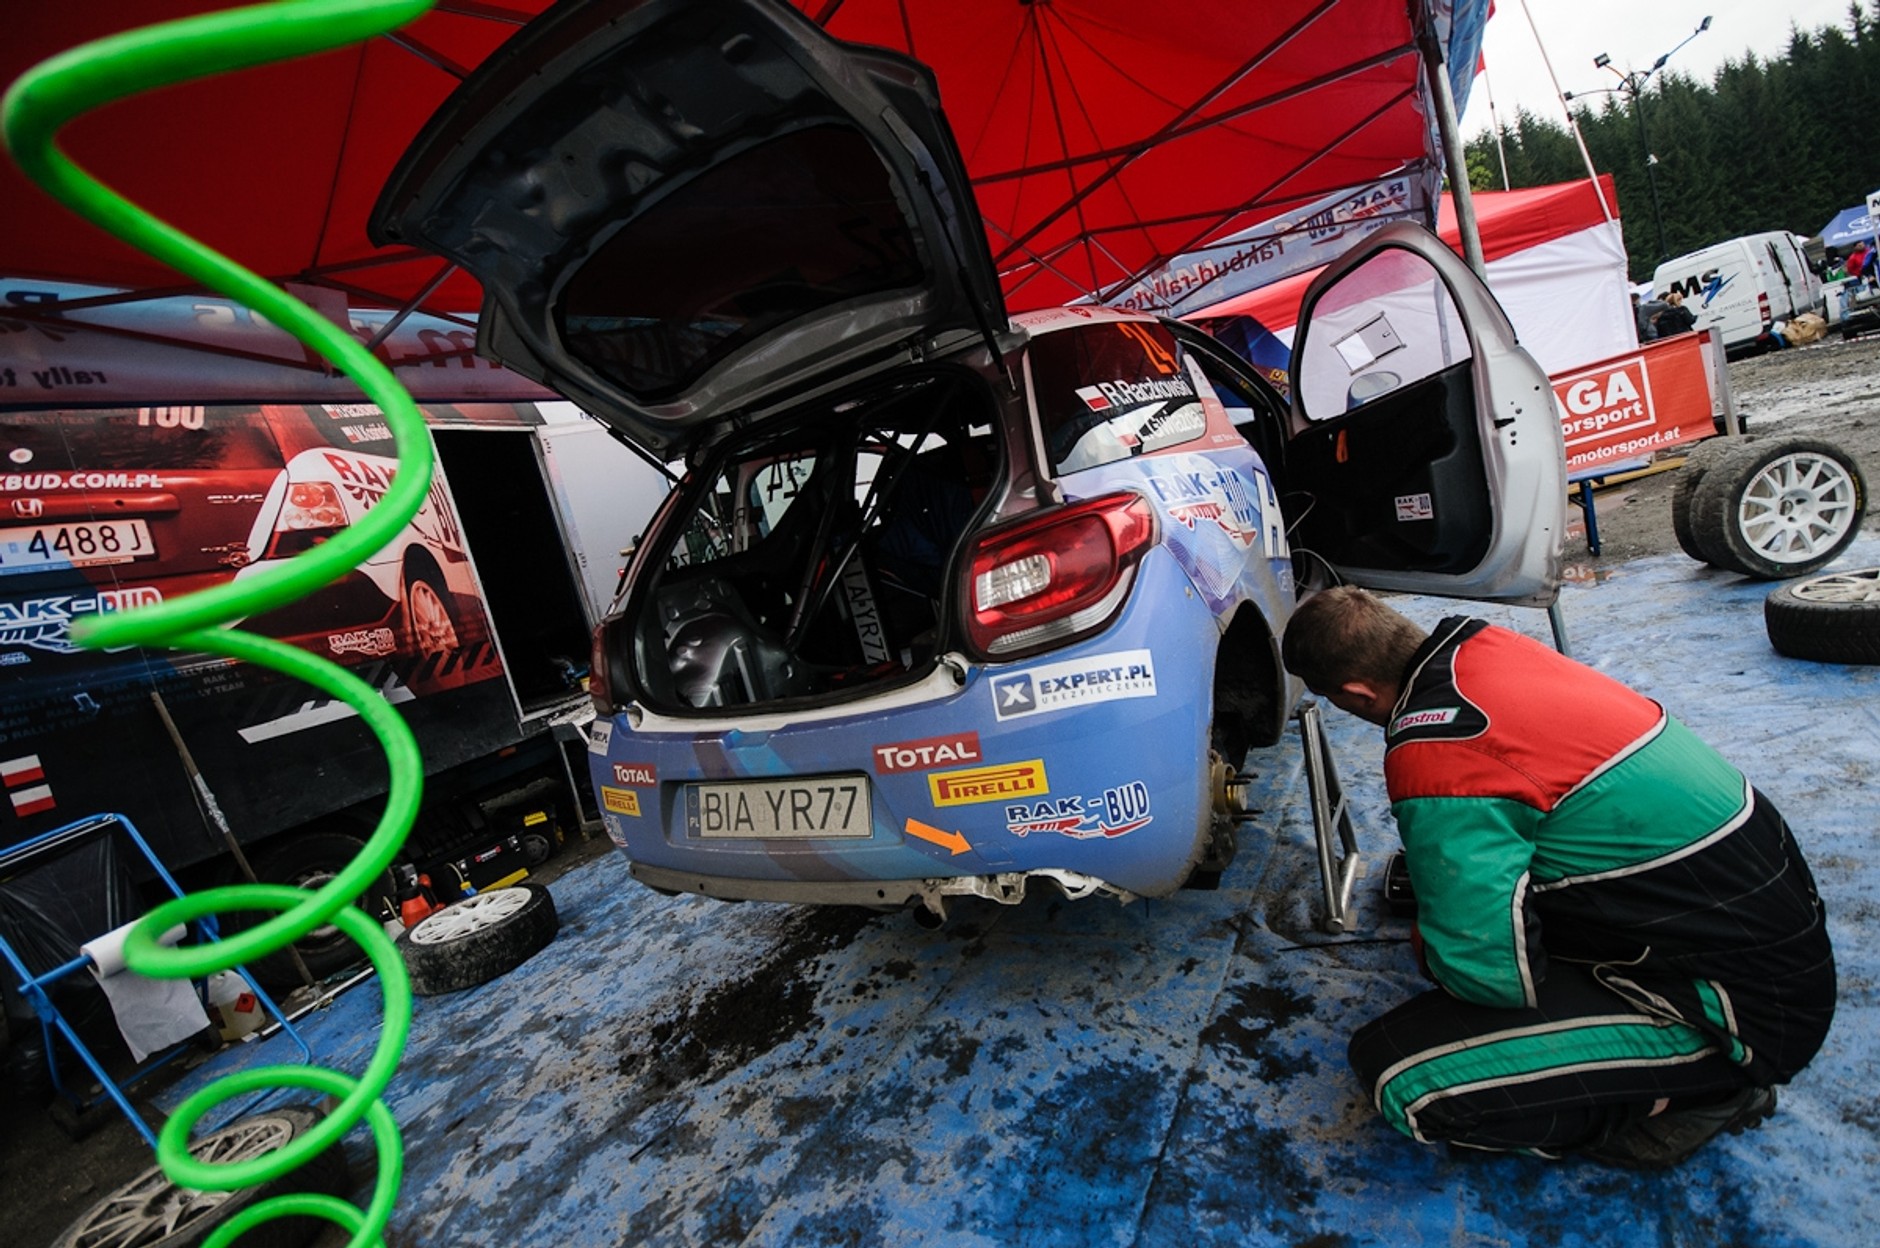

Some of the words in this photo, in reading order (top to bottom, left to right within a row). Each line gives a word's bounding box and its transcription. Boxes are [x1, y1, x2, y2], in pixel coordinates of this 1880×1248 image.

[1039, 664, 1151, 695] EXPERT.PL
[876, 741, 978, 770] TOTAL
[613, 764, 656, 784] TOTAL
[936, 766, 1036, 800] PIRELLI
[705, 791, 755, 832] BIA
[765, 785, 858, 831] YR77
